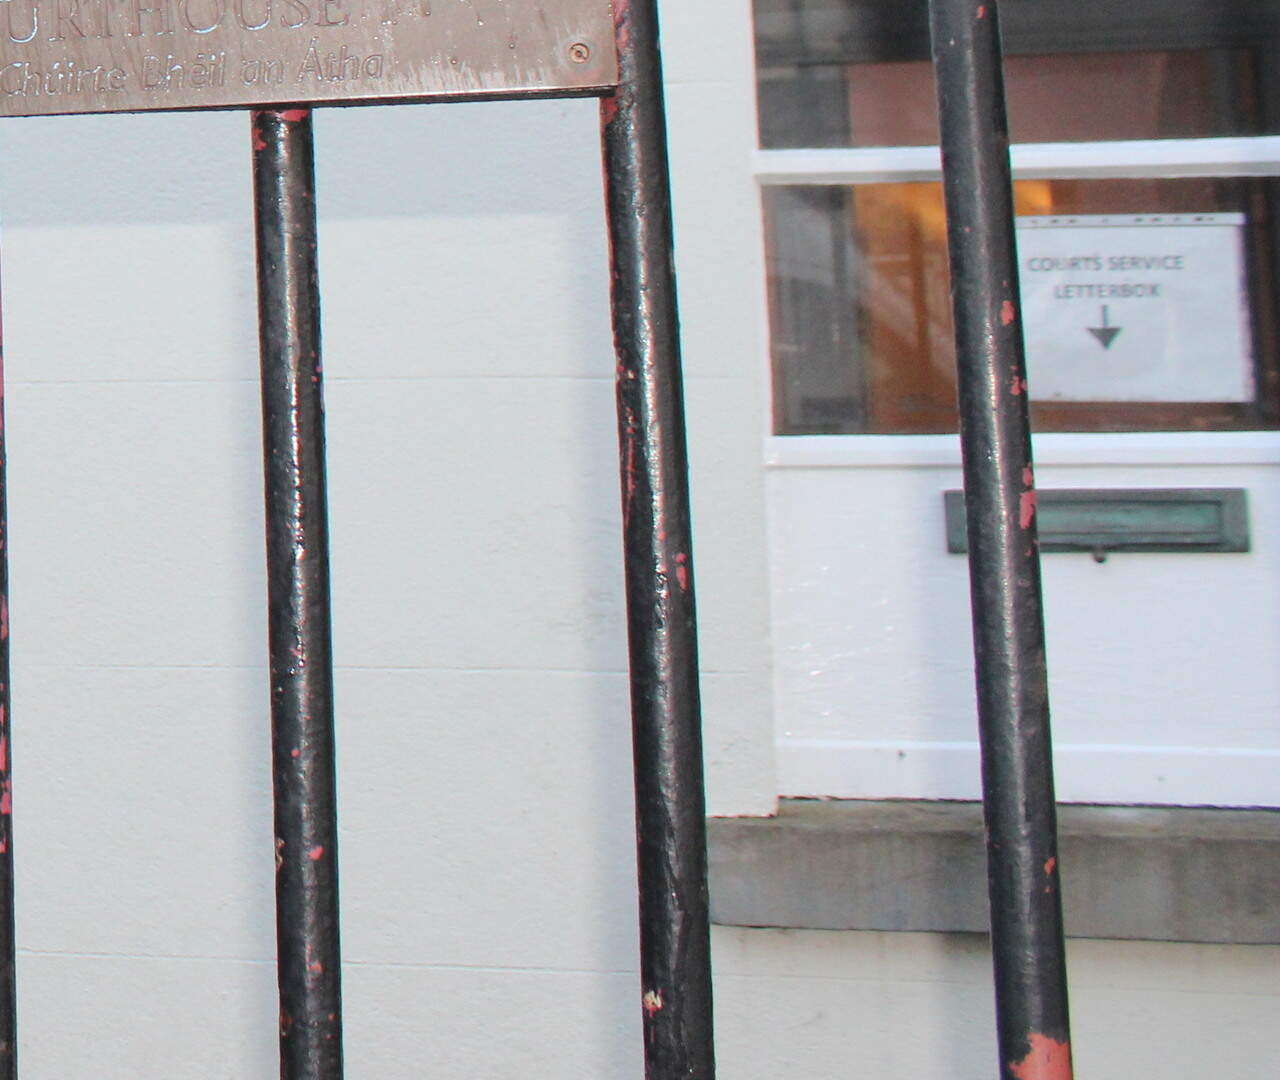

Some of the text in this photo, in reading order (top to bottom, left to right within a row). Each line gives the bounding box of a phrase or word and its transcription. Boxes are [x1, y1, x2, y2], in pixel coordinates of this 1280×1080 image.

[142, 50, 227, 91] Bhéil
[241, 58, 285, 88] an
[297, 35, 384, 83] Átha
[1026, 255, 1185, 272] COURTS SERVICE
[1054, 283, 1161, 299] LETTERBOX
